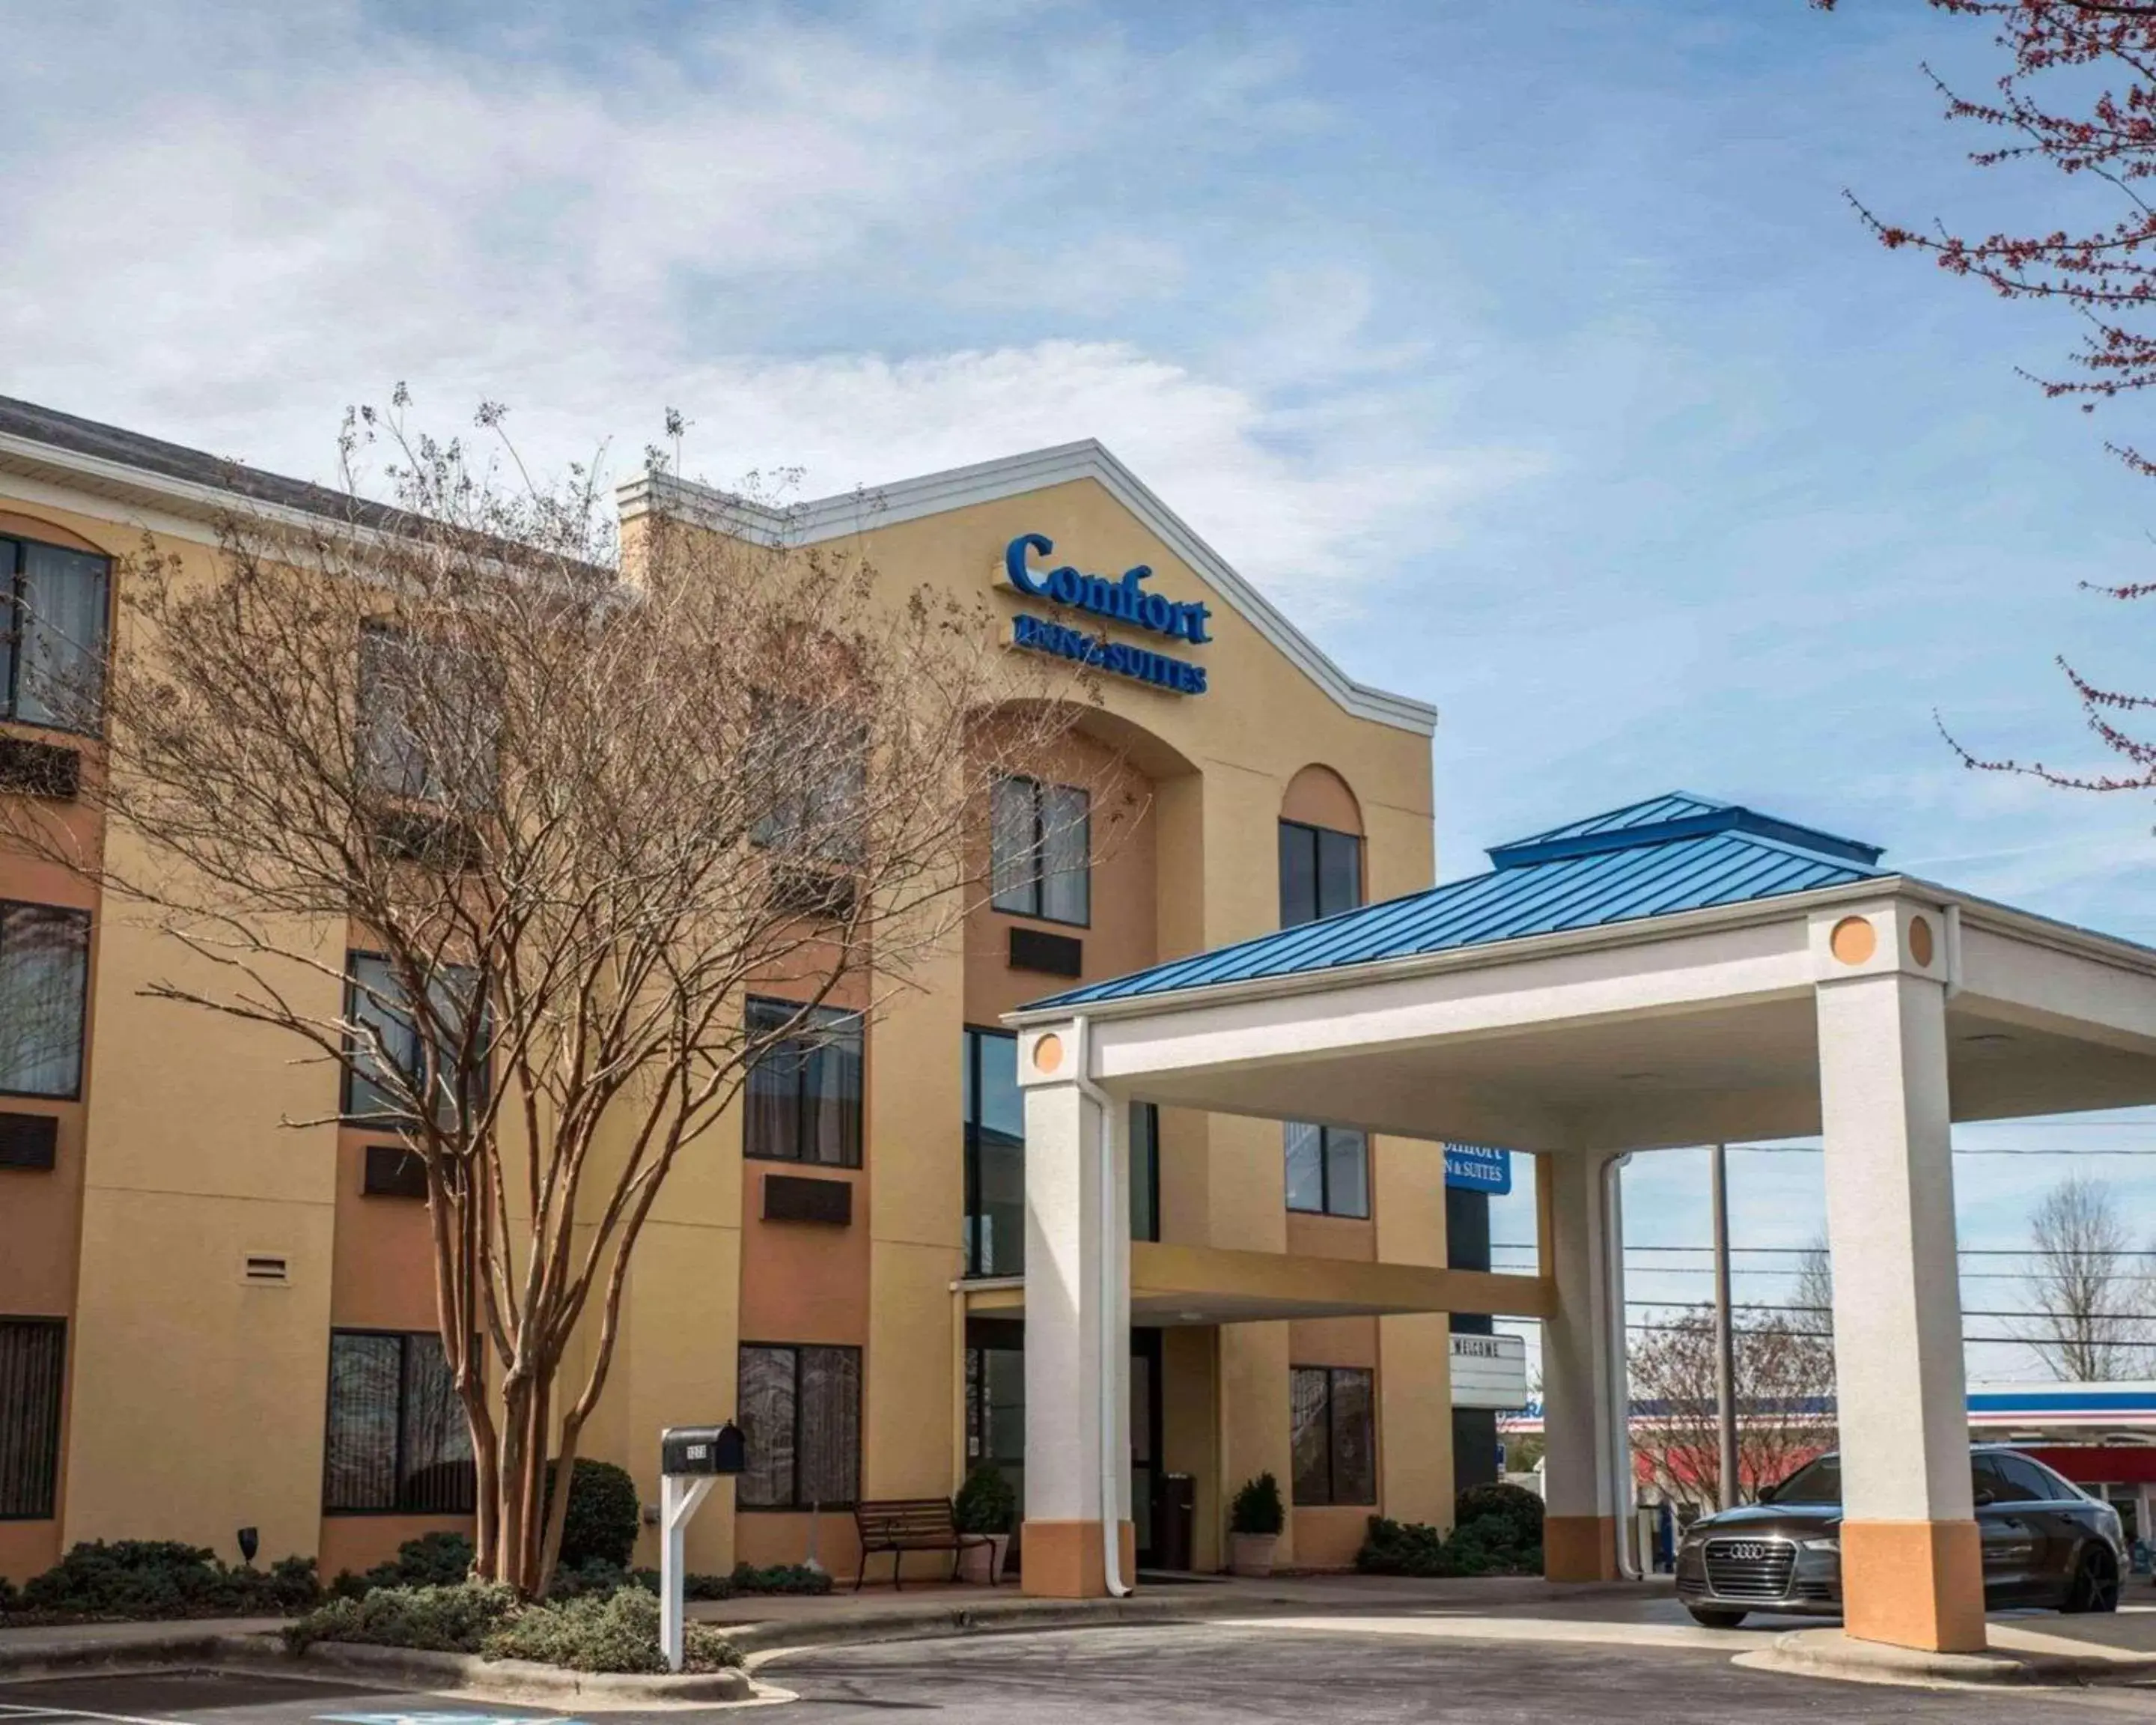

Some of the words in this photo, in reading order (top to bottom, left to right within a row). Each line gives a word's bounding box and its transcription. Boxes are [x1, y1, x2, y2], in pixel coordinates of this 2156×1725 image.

[1006, 533, 1213, 644] Comfort
[1102, 642, 1207, 694] SUITES
[1463, 1161, 1503, 1181] SUITES
[1455, 1338, 1498, 1357] WELCOME
